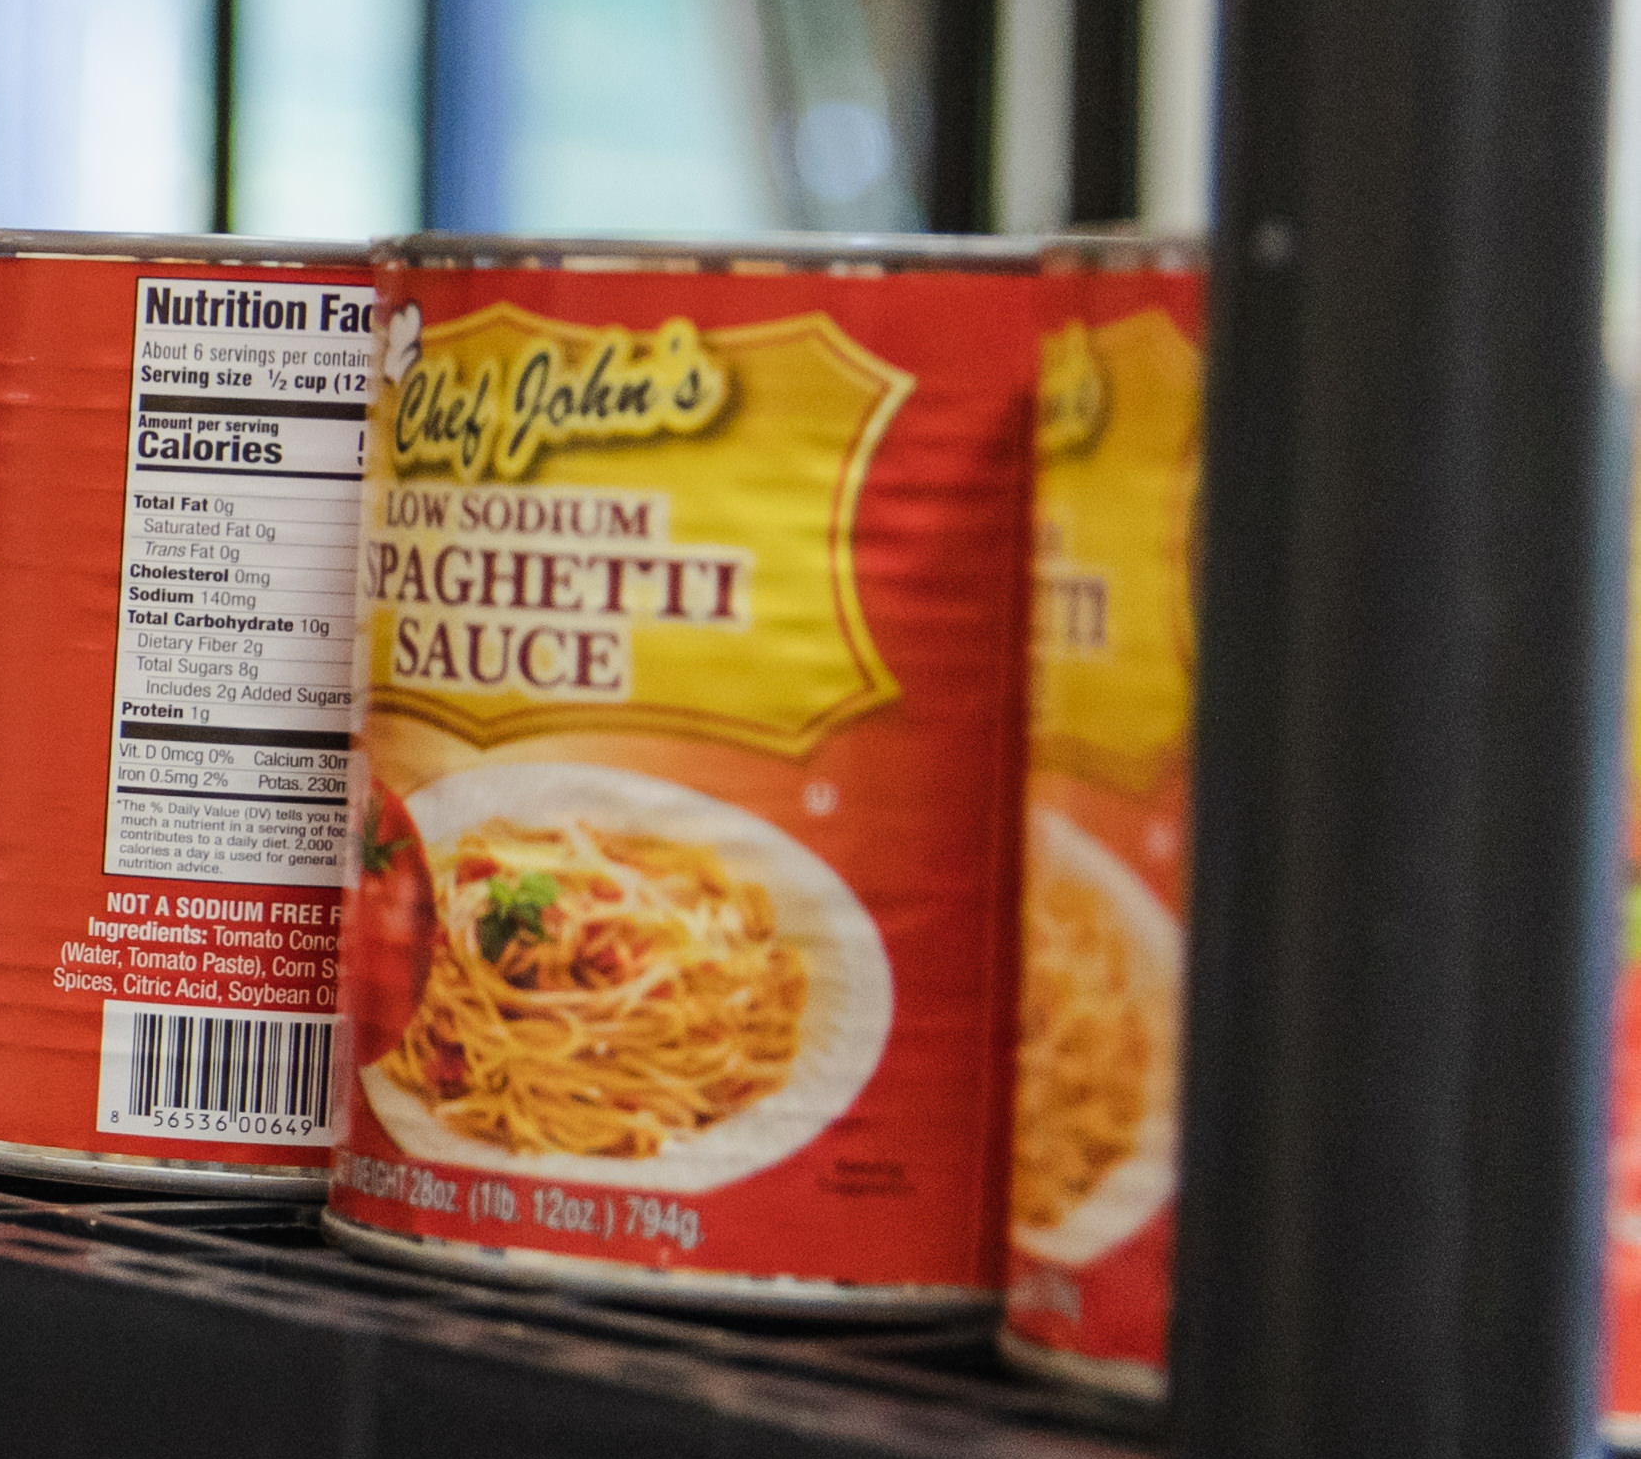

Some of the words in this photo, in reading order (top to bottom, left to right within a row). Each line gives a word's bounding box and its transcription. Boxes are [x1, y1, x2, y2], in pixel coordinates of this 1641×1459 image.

[145, 287, 306, 330] Nutrition
[142, 341, 187, 360] About
[194, 343, 203, 361] 6
[210, 345, 275, 367] servings
[283, 349, 307, 367] per
[141, 365, 209, 388] Serving
[217, 370, 252, 386] size
[294, 375, 326, 393] cup
[395, 369, 489, 467] Chef
[507, 336, 700, 457] John's
[138, 415, 192, 430] Amount
[198, 418, 219, 433] per
[226, 419, 279, 436] serving
[137, 430, 283, 464] Calories
[134, 495, 174, 510] Total
[181, 497, 208, 513] Fat
[214, 499, 234, 515] 0g
[386, 490, 449, 529] LOW
[458, 492, 650, 538] SODIUM
[144, 518, 220, 536] Saturated
[226, 522, 250, 537] Fat
[256, 524, 276, 540] 0g
[145, 541, 186, 557] Trans
[190, 544, 214, 558] Fat
[220, 545, 240, 563] 0g
[130, 564, 229, 582] Cholesterol
[235, 569, 270, 587] 0mg
[365, 541, 739, 622] SPAGHETTI
[129, 587, 194, 604] Sodium
[202, 591, 256, 610] 140mg
[128, 610, 168, 625] Total
[174, 613, 294, 633] Carbohydrate
[301, 619, 330, 636] 10g
[137, 633, 193, 653] Dietary
[198, 637, 237, 653] Fiber
[244, 639, 263, 657] 2g
[394, 617, 622, 691] SAUCE
[137, 656, 172, 673] Total
[178, 659, 233, 678] Sugars
[238, 662, 259, 680] 8g
[146, 680, 211, 698] Includes
[217, 684, 237, 702] 2g
[241, 686, 291, 702] Added
[297, 688, 352, 706] Sugars
[122, 702, 184, 719] Protein
[191, 706, 210, 723] 1g
[119, 744, 141, 759] Vit.
[146, 745, 156, 759] D
[162, 746, 203, 765] 0mcg
[208, 749, 234, 765] 0%
[254, 751, 314, 769] Calcium
[118, 766, 145, 782] Iron
[150, 768, 198, 788] 0.5mg
[203, 772, 229, 787] 2%
[258, 775, 303, 791] Potas.
[150, 802, 163, 814] %
[168, 803, 200, 817] Daily
[204, 805, 240, 818] Value
[245, 807, 271, 820] (DV)
[276, 809, 302, 822] tells
[307, 813, 331, 824] you
[121, 815, 156, 827] much
[162, 820, 169, 828] a
[174, 818, 225, 831] nutrient
[230, 821, 241, 832] in
[246, 823, 254, 833] a
[258, 824, 306, 838] serving
[310, 826, 324, 836] of
[120, 830, 193, 844] contributes
[198, 834, 210, 845] to
[214, 836, 222, 845] a
[227, 835, 257, 849] daily
[262, 837, 290, 849] diet.
[295, 839, 333, 852] 2,000
[118, 858, 172, 870] nutrition
[177, 860, 223, 874] advice.
[119, 844, 170, 856] calories
[174, 849, 182, 857] a
[186, 847, 210, 862] day
[214, 850, 225, 859] is
[229, 851, 261, 862] used
[266, 852, 283, 863] for
[288, 853, 337, 867] general
[107, 892, 150, 914] NOT
[155, 896, 170, 916] A
[176, 896, 263, 922] SODIUM
[271, 902, 323, 924] FREE
[88, 917, 207, 945] Ingredients:
[214, 925, 282, 949] Tomato
[61, 941, 122, 968] (Water,
[128, 946, 197, 972] Tomato
[203, 952, 265, 978] Paste),
[273, 957, 315, 977] Corn
[53, 967, 116, 994] Spices,
[123, 973, 171, 996] Citric
[176, 978, 222, 1002] Acid,
[228, 982, 310, 1006] Soybean
[110, 1111, 120, 1123] 8
[154, 1111, 227, 1131] 56536
[239, 1116, 313, 1137] 00649
